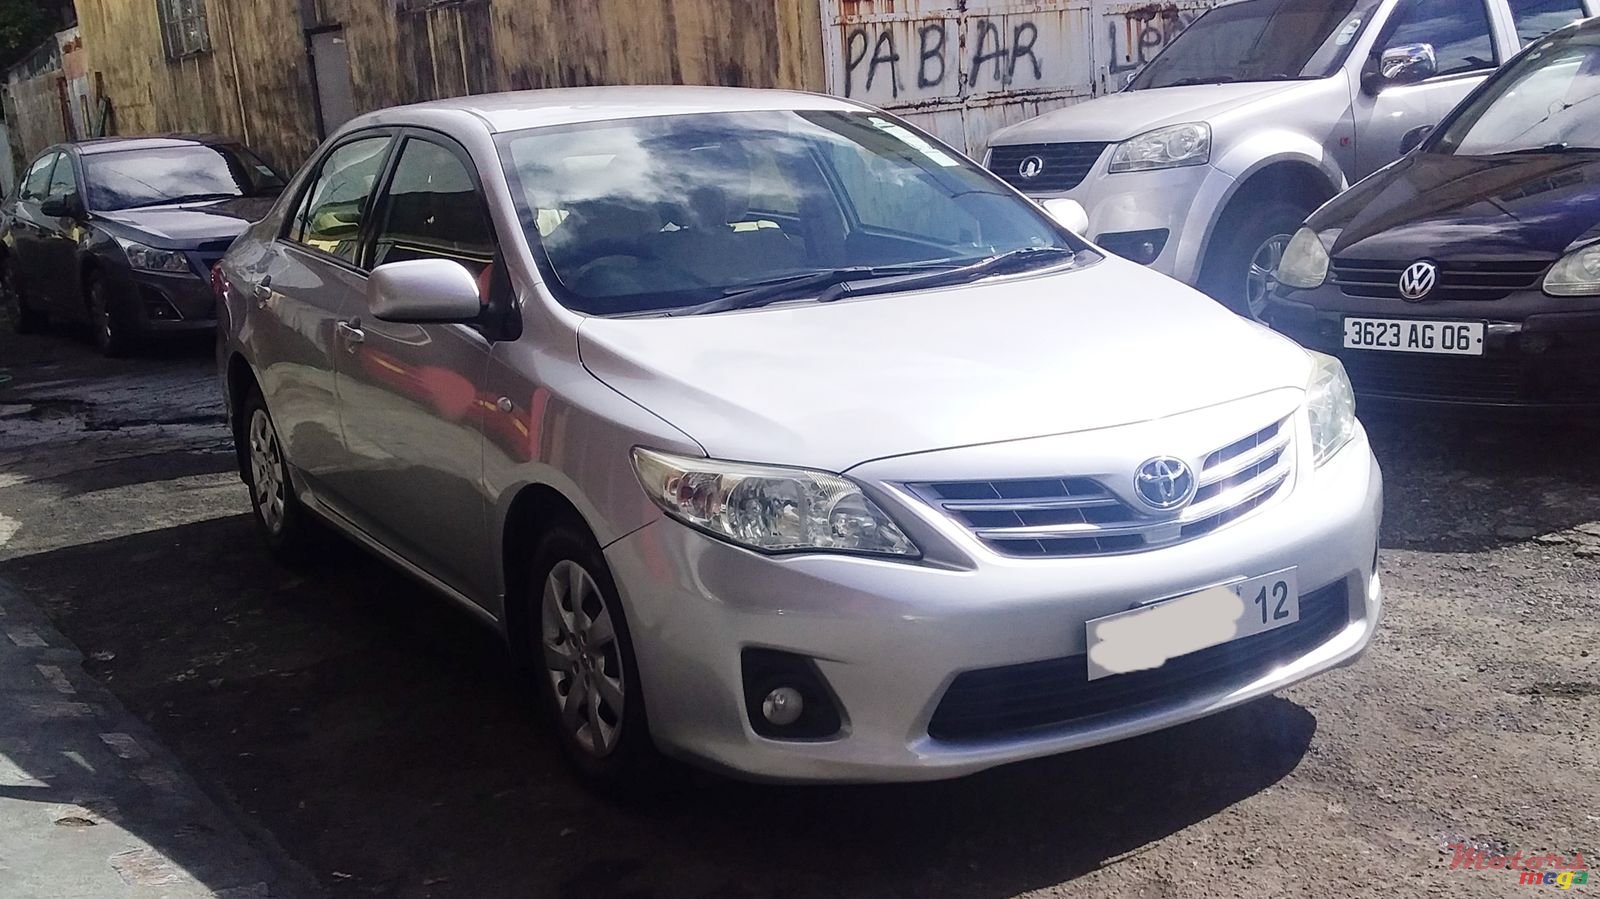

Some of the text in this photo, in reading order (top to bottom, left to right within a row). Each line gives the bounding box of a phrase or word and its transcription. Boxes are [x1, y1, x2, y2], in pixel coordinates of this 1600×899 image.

[1351, 321, 1470, 351] 3623 AG 06
[1254, 580, 1289, 625] 12
